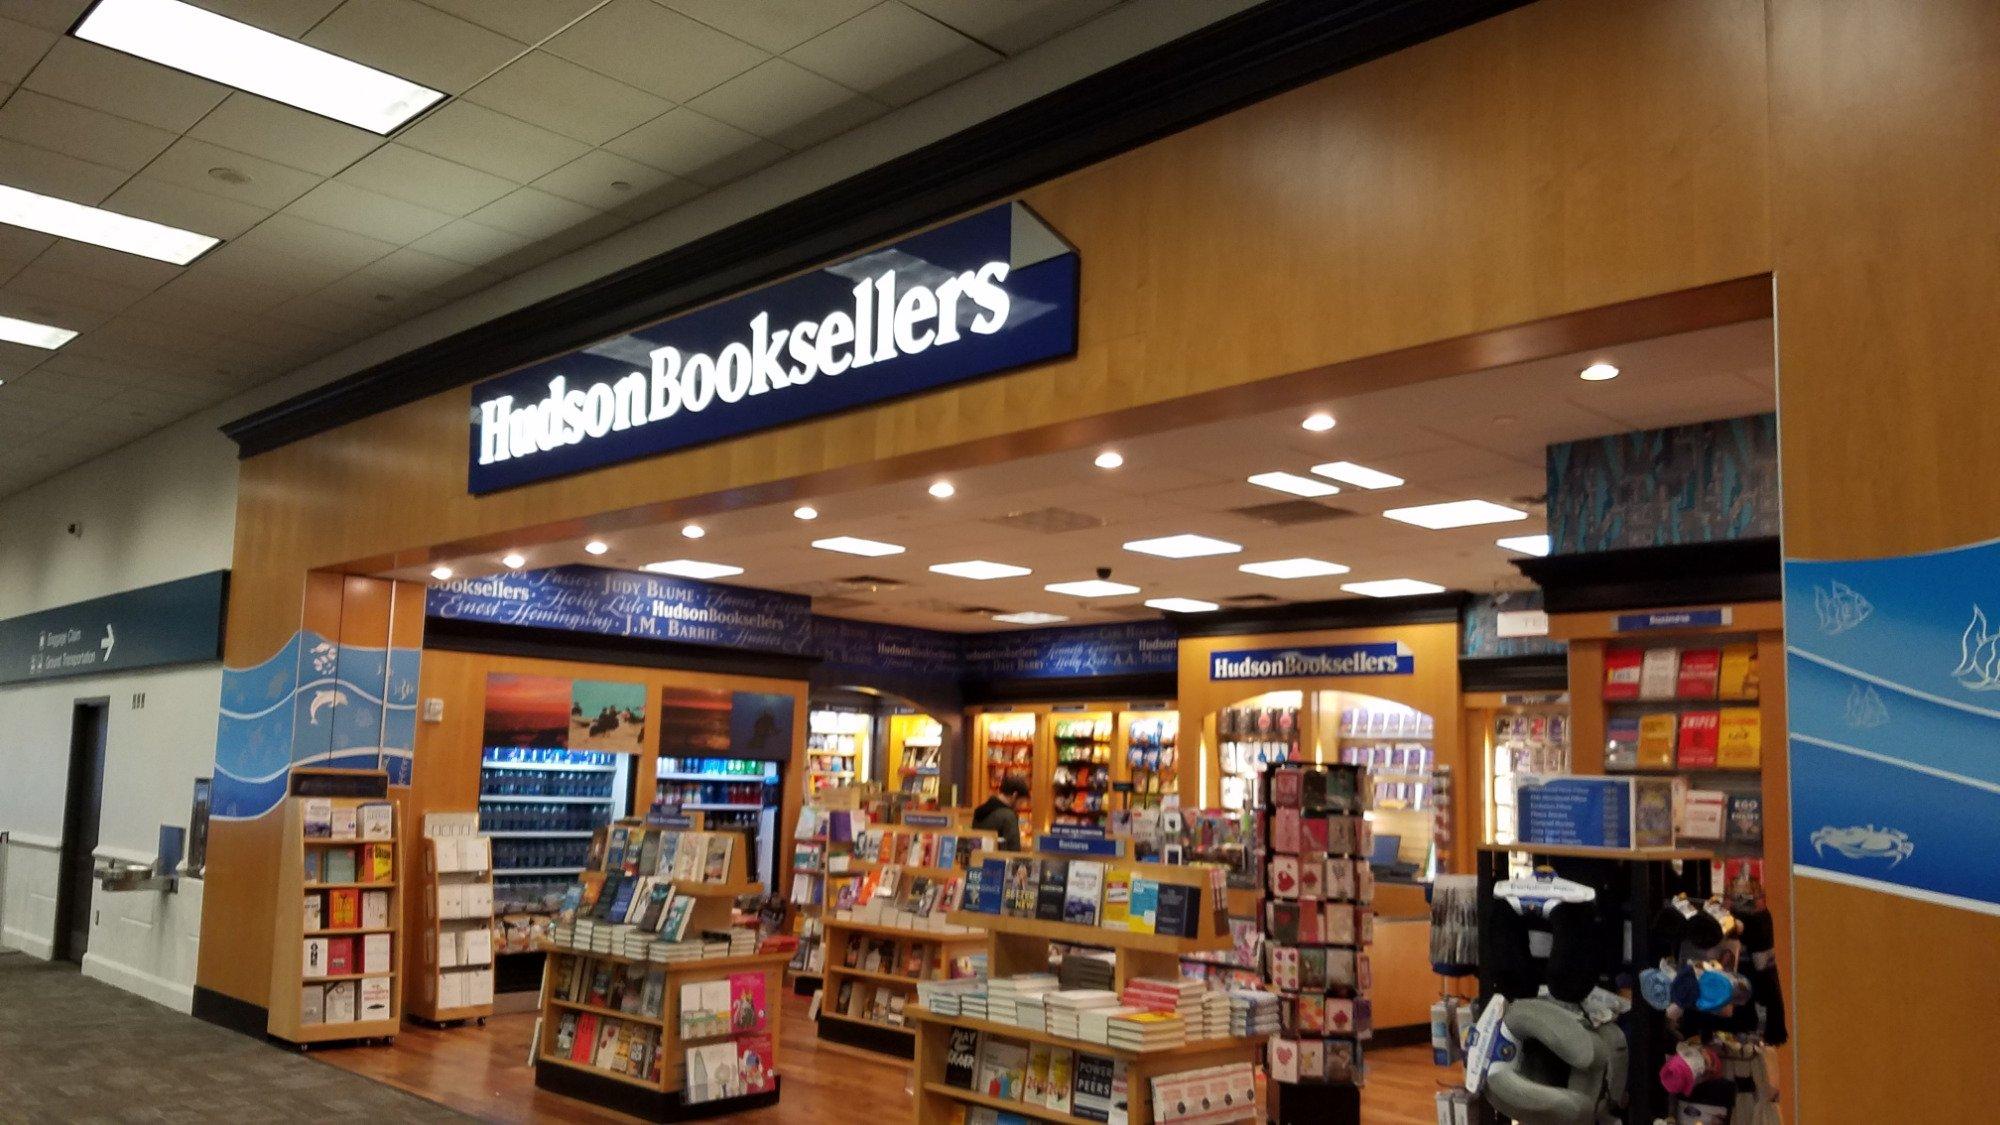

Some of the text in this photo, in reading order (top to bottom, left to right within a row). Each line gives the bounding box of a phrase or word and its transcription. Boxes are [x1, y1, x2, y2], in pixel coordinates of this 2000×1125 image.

[479, 261, 1011, 465] HudsonBooksellers
[428, 579, 530, 602] ooksellers
[1214, 651, 1397, 678] HudsonBooksellers
[1078, 1079, 1110, 1095] PEERS
